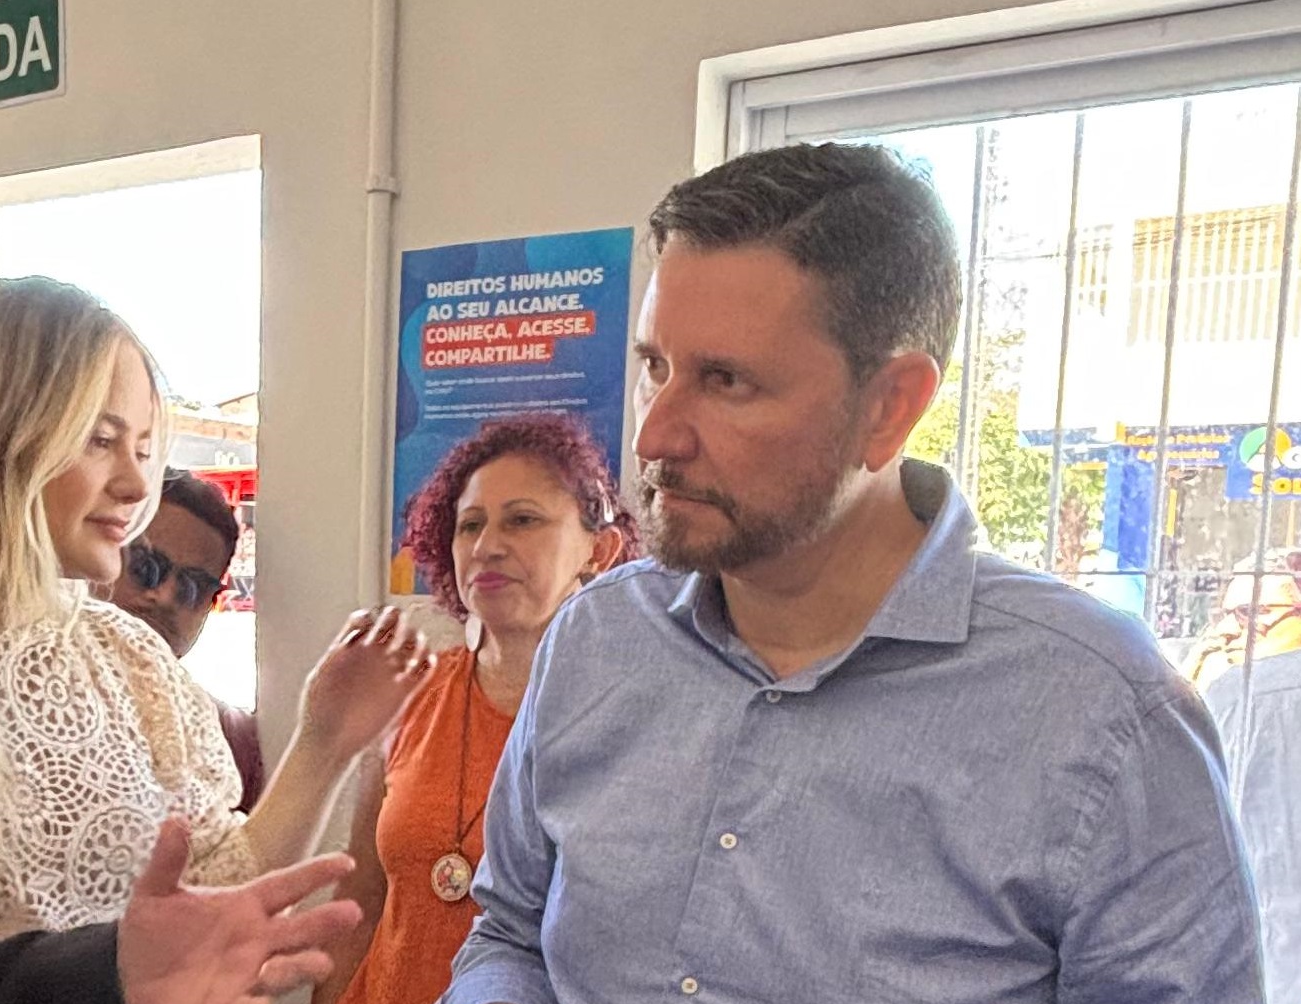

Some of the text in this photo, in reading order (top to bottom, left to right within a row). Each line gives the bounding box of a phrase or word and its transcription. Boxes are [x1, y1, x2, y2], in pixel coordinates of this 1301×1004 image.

[426, 267, 604, 299] DIREITOS HUMANOS
[426, 293, 584, 322] AO SEU ALCANCE.
[425, 343, 551, 367] COMPARTILHE.
